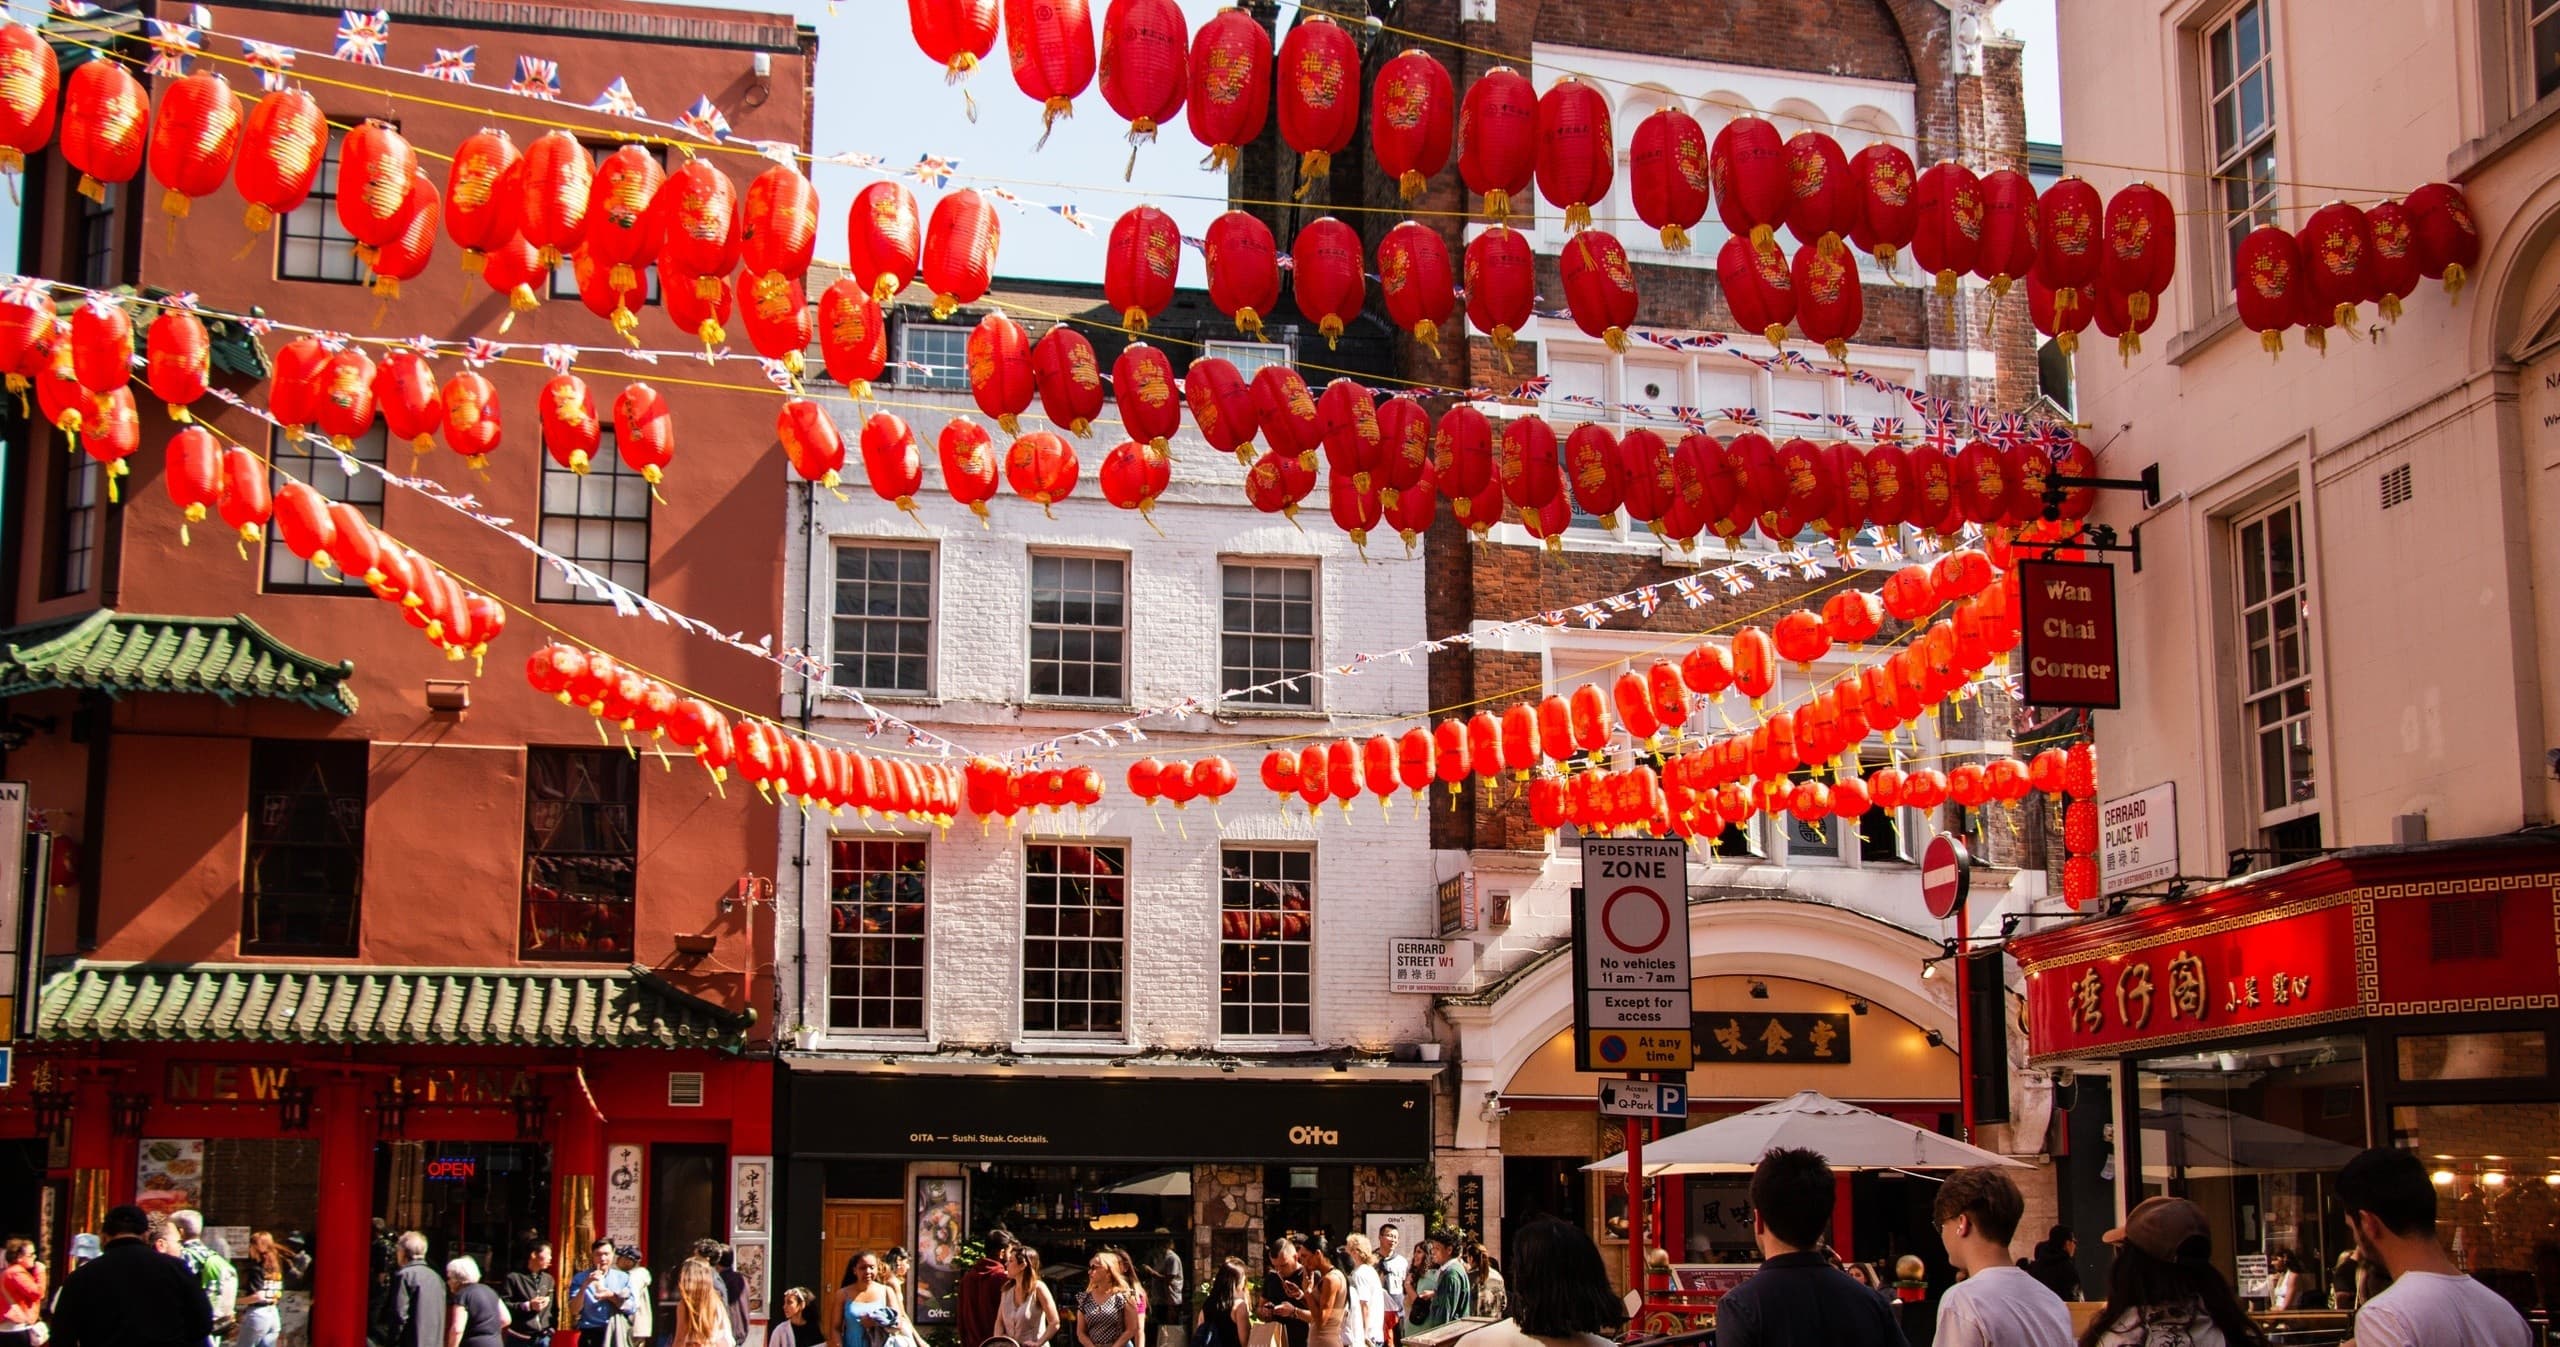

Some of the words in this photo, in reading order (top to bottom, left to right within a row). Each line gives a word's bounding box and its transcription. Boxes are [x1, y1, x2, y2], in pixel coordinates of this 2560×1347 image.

[2045, 580, 2092, 602] Wan
[2043, 618, 2096, 639] Chai
[2031, 656, 2111, 680] Corner
[2104, 799, 2146, 828] GERRARD
[2105, 825, 2132, 849] PLACE
[2134, 820, 2149, 840] W1
[1589, 845, 1679, 857] PEDESTRIAN
[1602, 861, 1667, 878] ZONE
[1397, 943, 1446, 955] GERRARD
[1397, 956, 1435, 967] STREET
[1439, 957, 1454, 967] W1
[1600, 957, 1619, 969] No
[1623, 958, 1676, 969] vehicles
[1602, 973, 1613, 983] 11
[1616, 974, 1635, 983] am
[1646, 972, 1653, 983] 7
[1656, 974, 1675, 983] am
[1605, 997, 1650, 1009] Except
[1655, 997, 1673, 1007] for
[1618, 1012, 1661, 1021] access
[1693, 1018, 1837, 1056] 味食堂
[1639, 1037, 1653, 1048] At
[1659, 1039, 1681, 1050] any
[1646, 1051, 1675, 1061] time
[1402, 1101, 1415, 1109] 47
[1618, 1099, 1654, 1110] Q-Park
[910, 1134, 934, 1142] OITA
[952, 1134, 978, 1143] Sushi.
[980, 1134, 1006, 1143] Steak.
[1007, 1134, 1049, 1143] Cocktails.
[1289, 1126, 1339, 1145] Oita
[428, 1162, 475, 1176] OPEN
